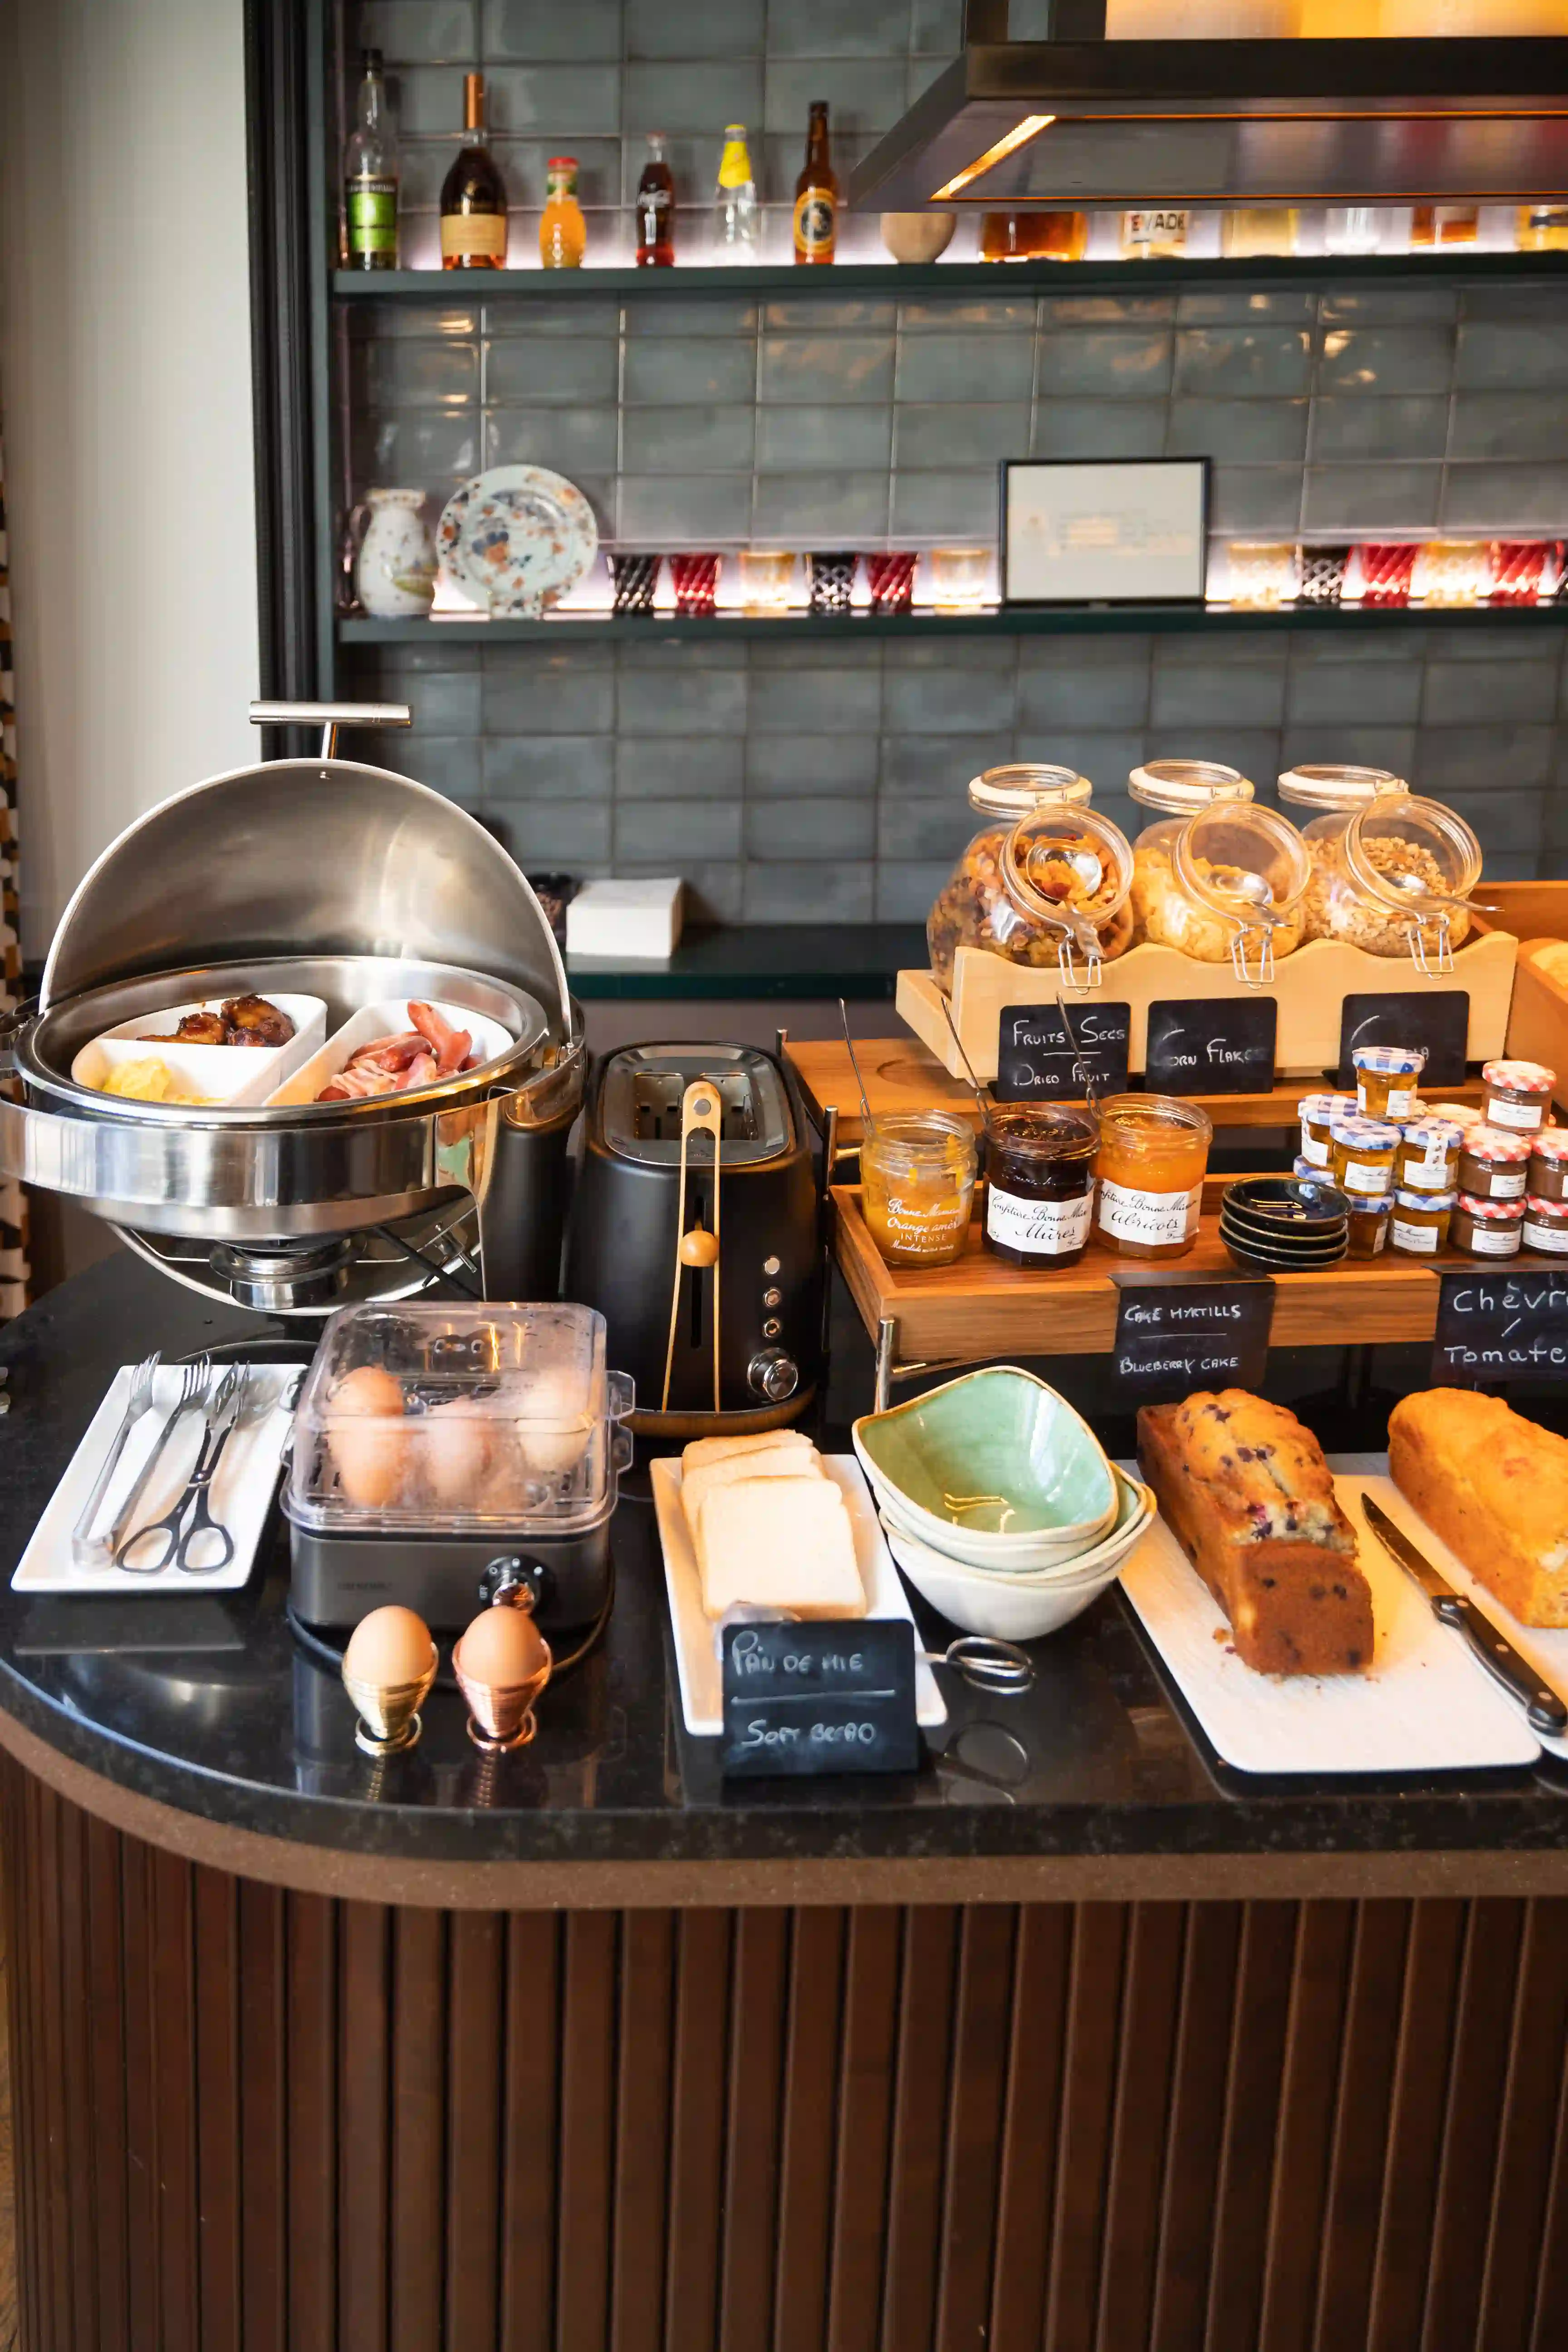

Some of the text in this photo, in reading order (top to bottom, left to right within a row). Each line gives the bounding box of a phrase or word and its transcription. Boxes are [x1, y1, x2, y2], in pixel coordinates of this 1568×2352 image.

[1014, 1016, 1125, 1046] FRUITS SECS
[1013, 1061, 1110, 1085] DRIED FRUIT
[992, 1196, 1031, 1220] Confiture
[1032, 1205, 1068, 1222] Bonne
[1130, 1194, 1166, 1212] Bonne
[887, 1217, 929, 1234] Orange
[901, 1233, 947, 1243] INTENSE
[1453, 1281, 1568, 1312] Chèvr
[1124, 1305, 1162, 1323] CAKE
[1120, 1357, 1239, 1374] BLUEBERRY CAKE
[732, 1630, 776, 1677] PAIN
[783, 1655, 811, 1674] DE
